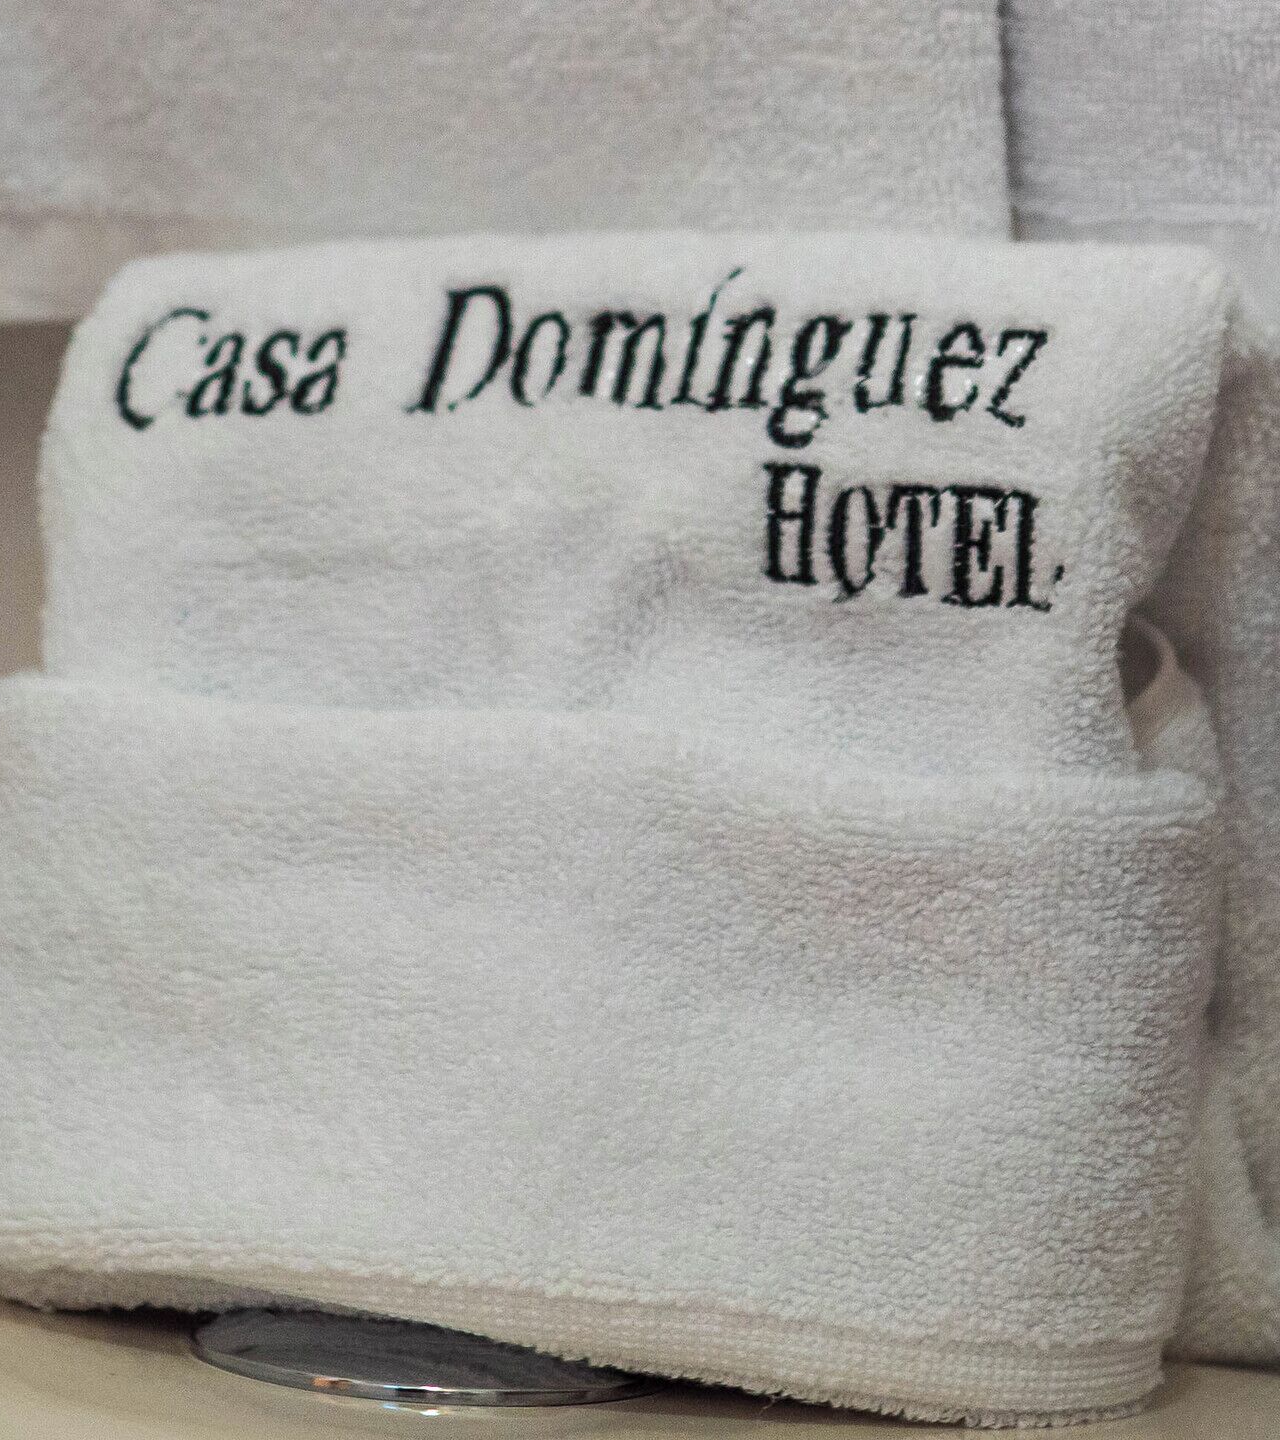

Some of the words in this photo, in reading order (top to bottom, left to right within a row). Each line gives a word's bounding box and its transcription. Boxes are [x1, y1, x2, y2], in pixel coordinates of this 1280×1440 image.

[116, 307, 349, 431] Casa
[404, 266, 1052, 449] Domínguez
[762, 460, 1066, 614] HOTEL
